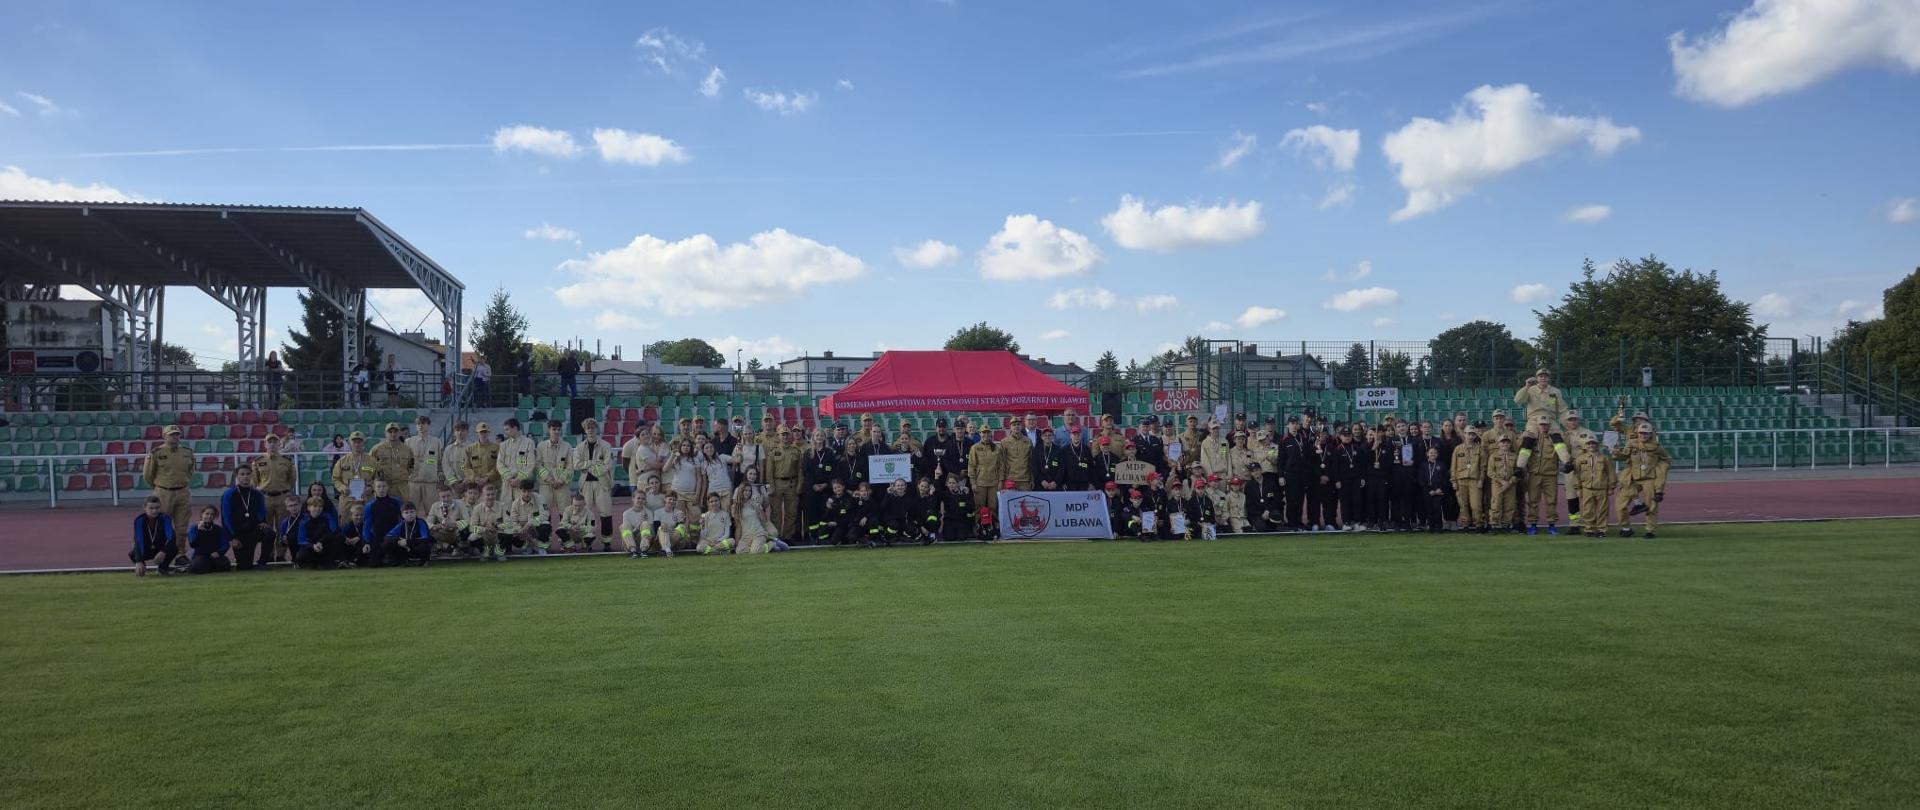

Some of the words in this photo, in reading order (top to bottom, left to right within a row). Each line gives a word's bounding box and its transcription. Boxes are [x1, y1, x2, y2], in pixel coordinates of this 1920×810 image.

[1167, 389, 1189, 399] MDP
[835, 401, 875, 409] KOMENDA
[877, 399, 926, 408] POWIATOWA
[1050, 396, 1059, 404] W
[1126, 463, 1146, 471] MDP
[1116, 473, 1147, 482] LUBAW
[1065, 503, 1089, 512] MDP
[1055, 519, 1103, 528] LUBAWA
